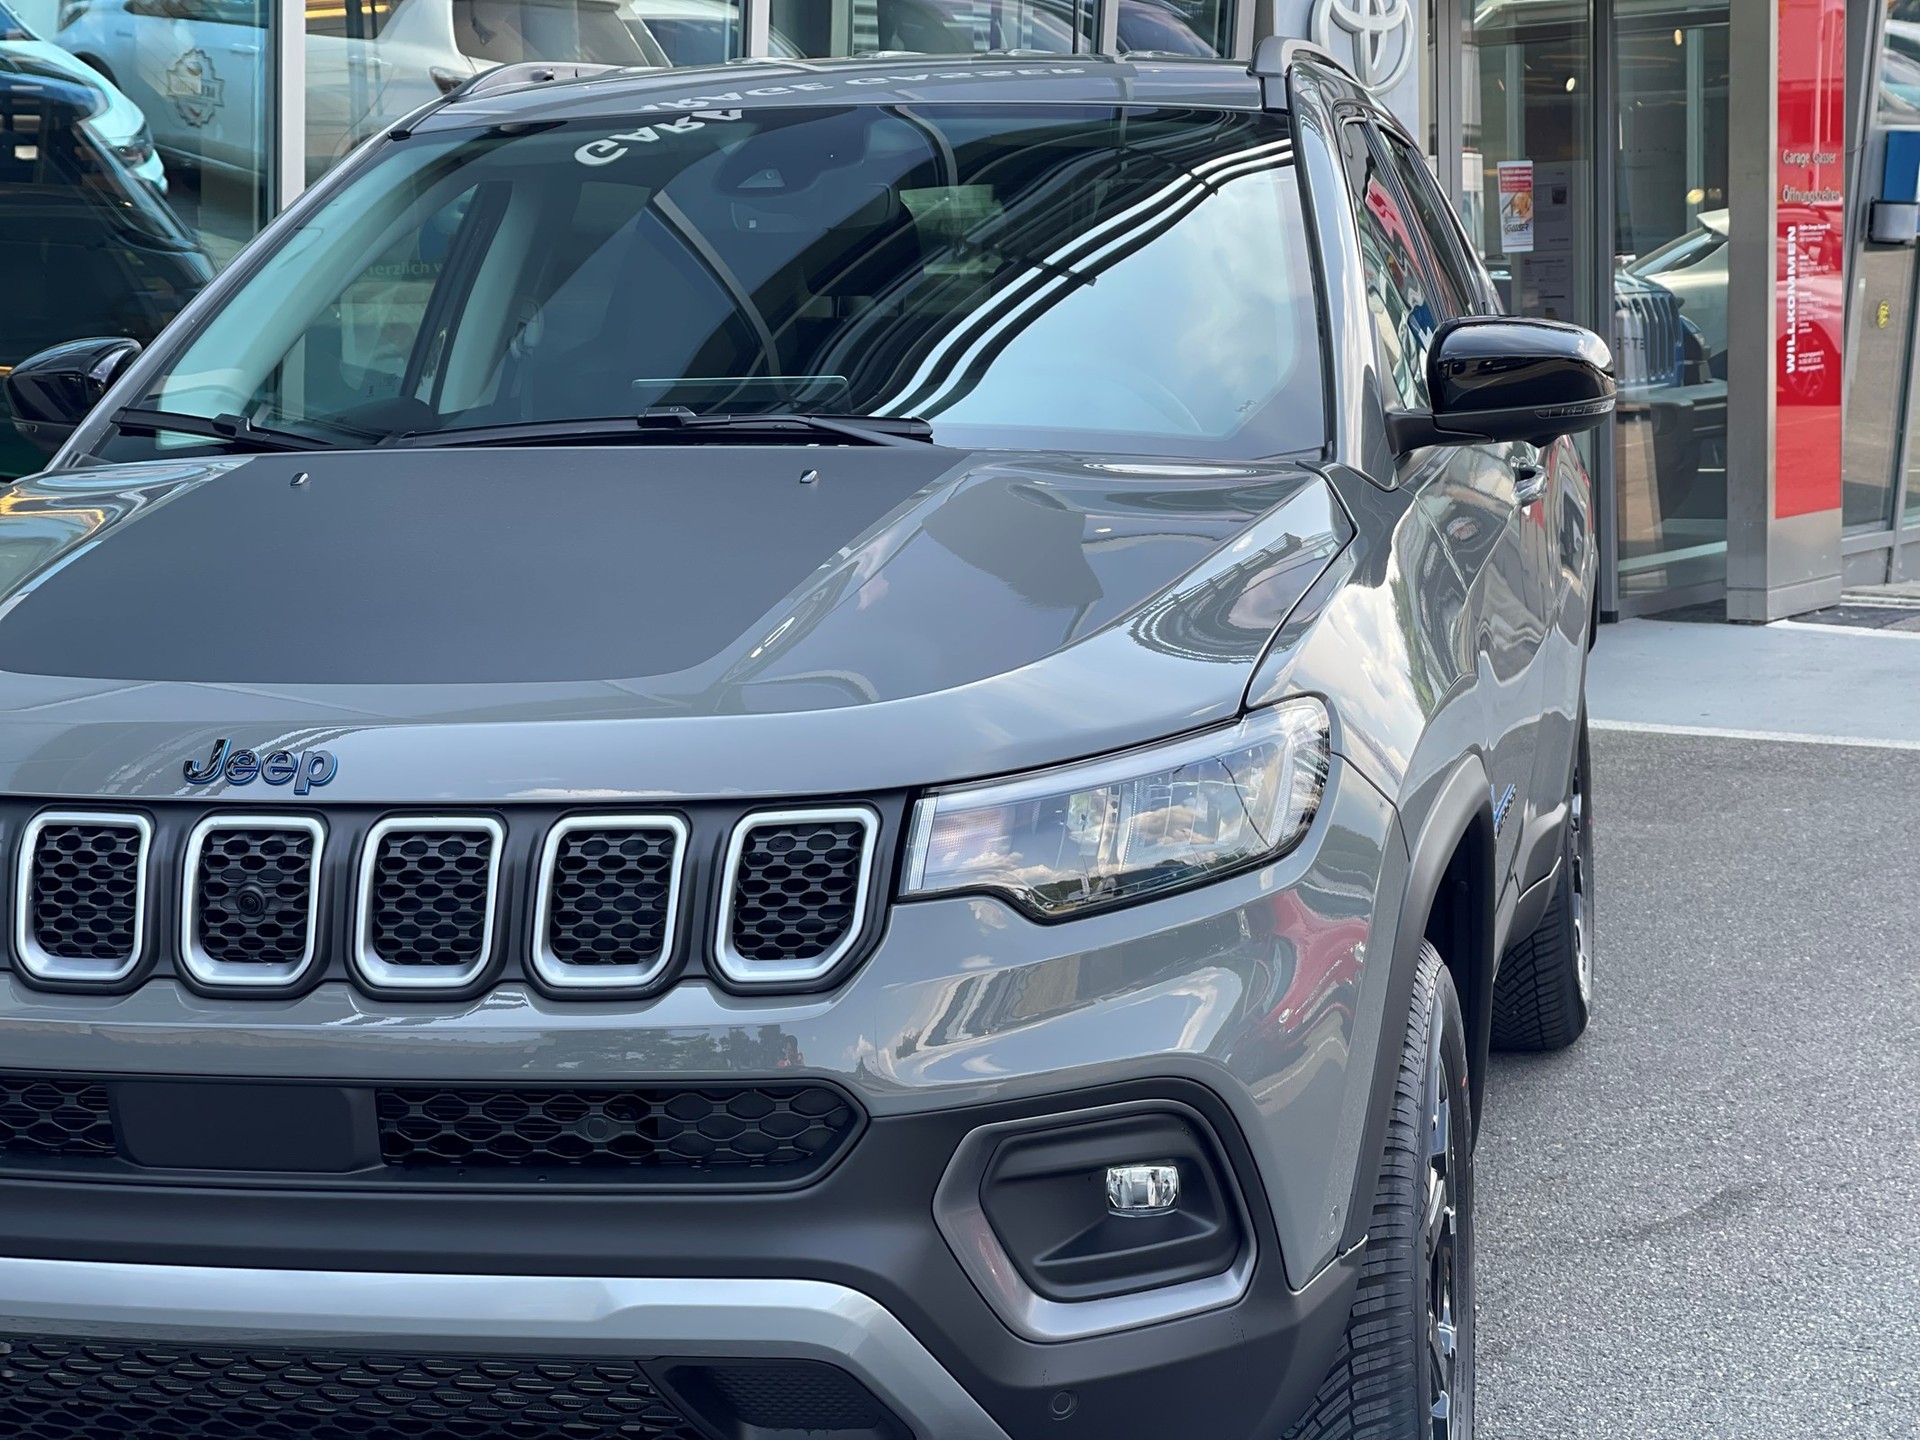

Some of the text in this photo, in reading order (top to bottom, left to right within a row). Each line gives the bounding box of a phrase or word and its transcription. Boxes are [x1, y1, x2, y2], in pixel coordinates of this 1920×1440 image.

[1782, 149, 1836, 168] Garage Gasser
[1786, 225, 1796, 374] WILLKOMMEN
[183, 738, 337, 795] Jeep
